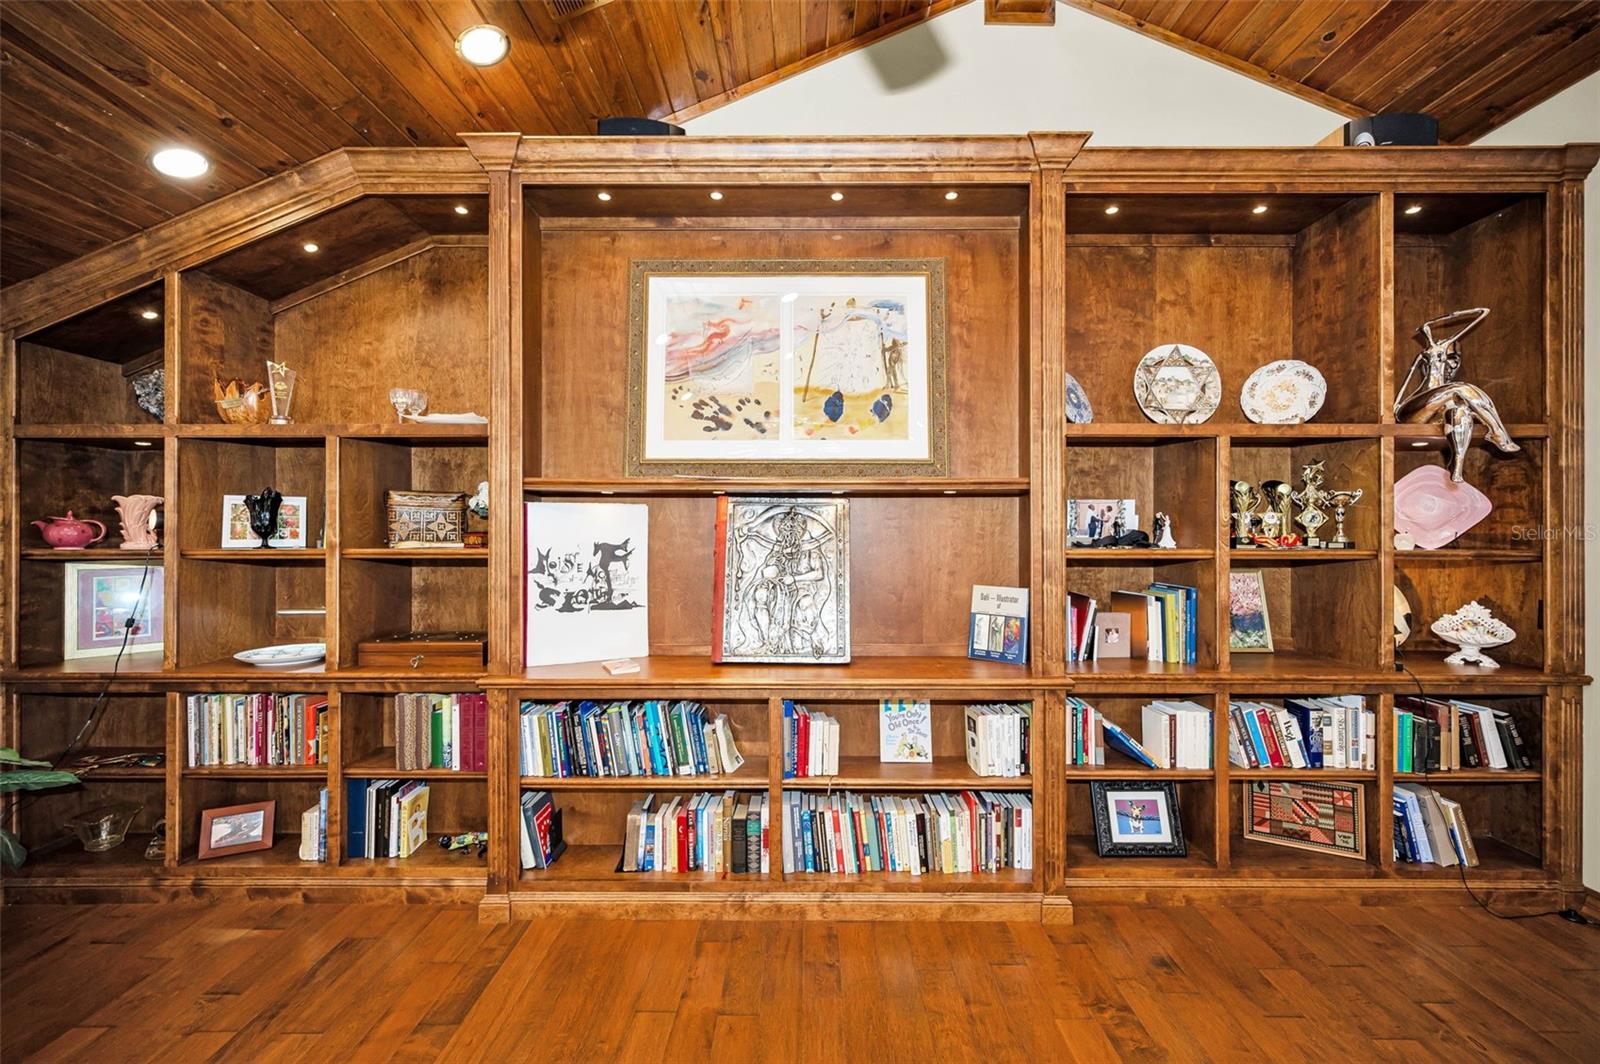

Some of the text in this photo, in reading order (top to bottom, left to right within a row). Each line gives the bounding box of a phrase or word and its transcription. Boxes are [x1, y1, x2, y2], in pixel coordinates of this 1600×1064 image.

[906, 710, 922, 719] Only
[888, 721, 902, 731] Old
[723, 816, 731, 841] Narnia
